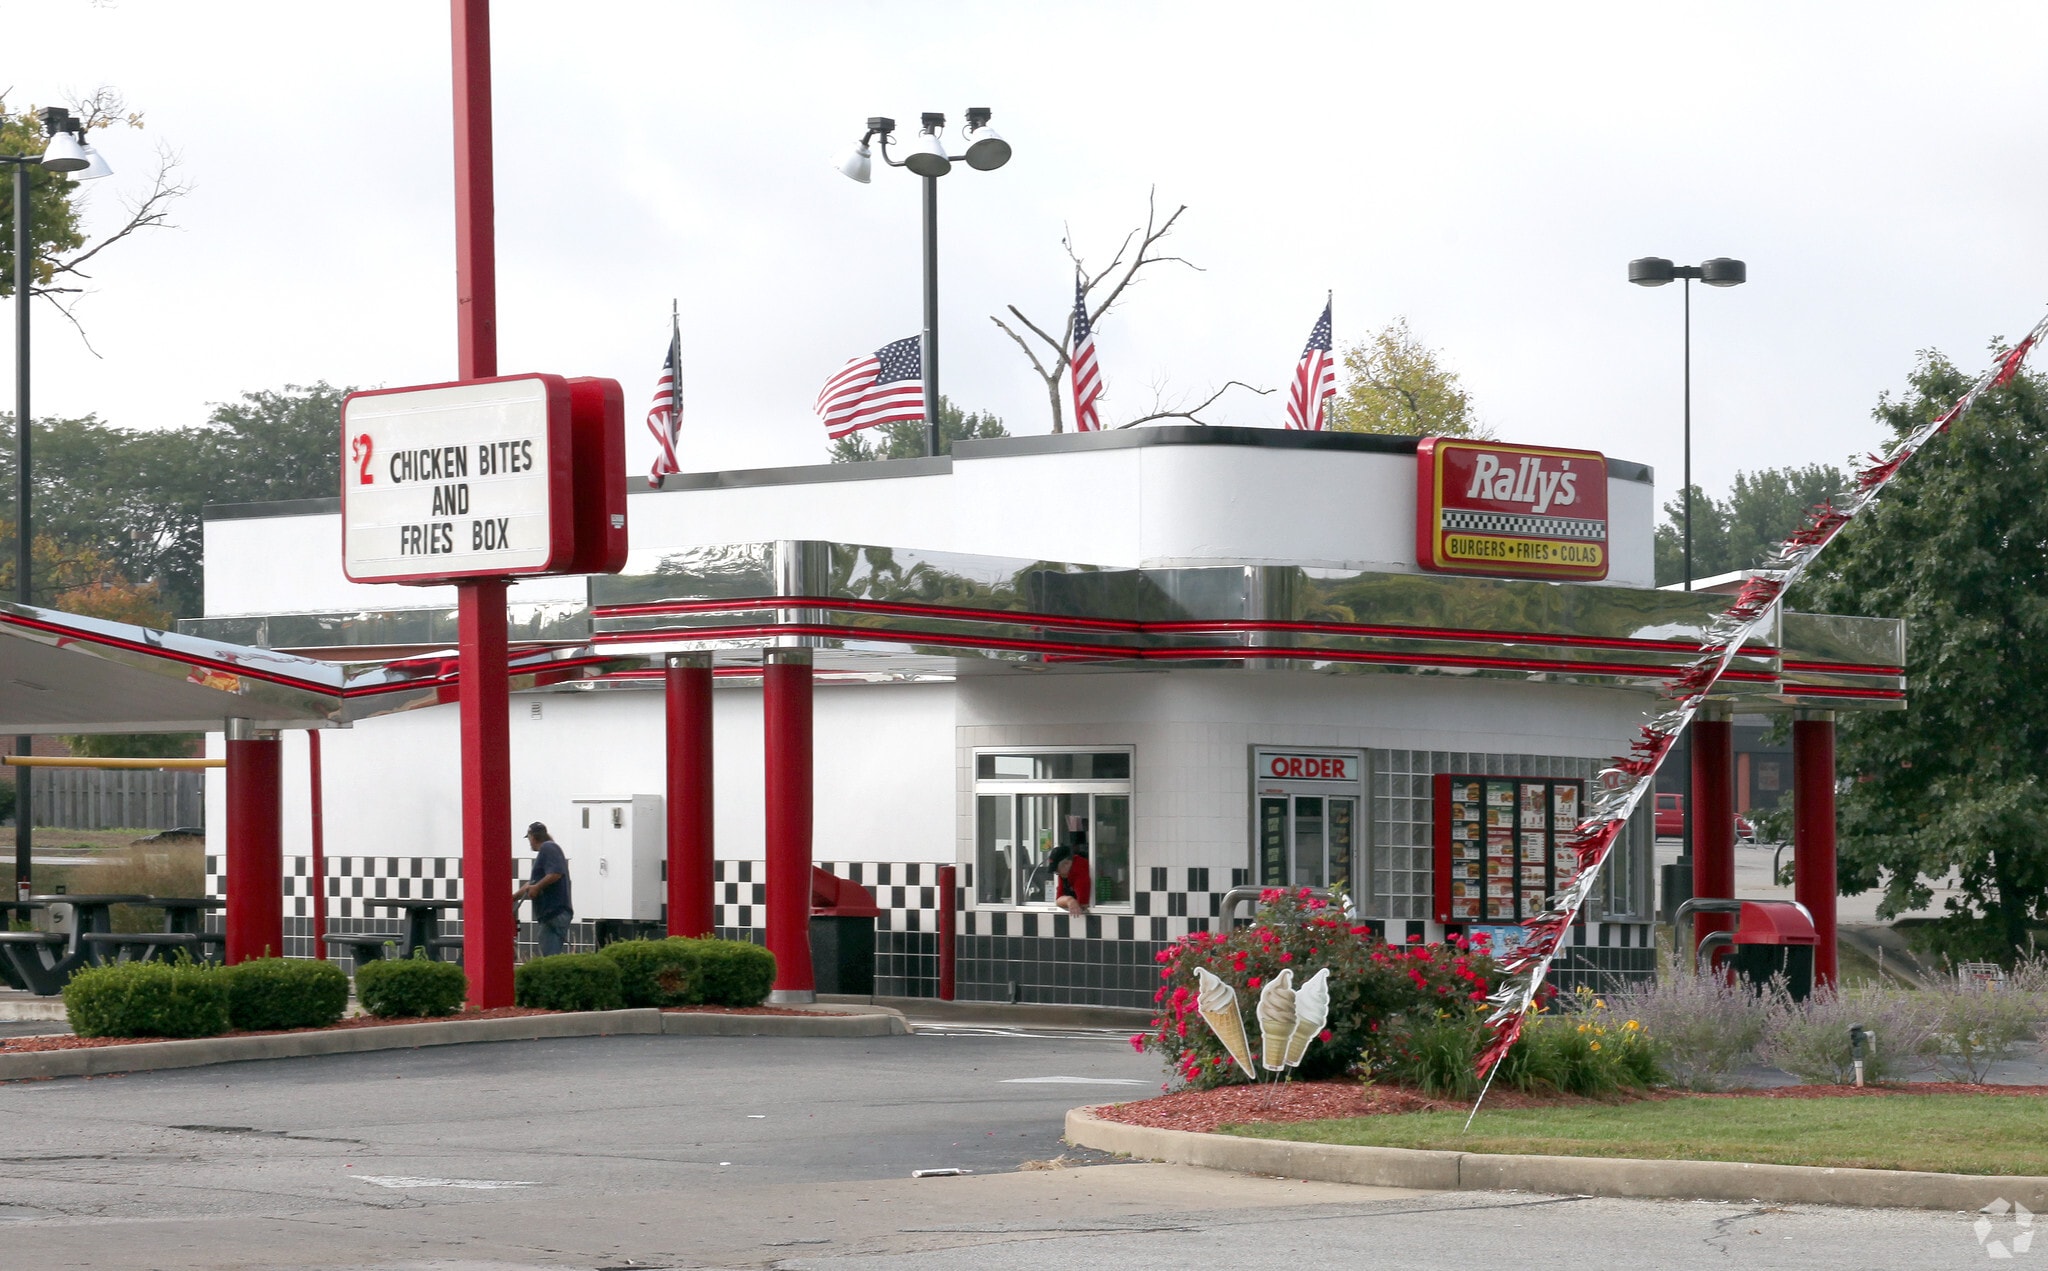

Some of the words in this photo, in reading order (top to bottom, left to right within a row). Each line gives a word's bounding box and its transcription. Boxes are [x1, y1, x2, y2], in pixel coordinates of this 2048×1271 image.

[352, 433, 374, 485] $2
[390, 446, 468, 484] CHICKEN
[479, 439, 532, 476] BITES
[431, 483, 470, 517] AND
[1466, 453, 1578, 514] Rally's
[400, 522, 453, 556] FRIES
[472, 518, 510, 551] BOX
[1451, 538, 1506, 557] BURGERS
[1516, 542, 1549, 560] FRIES
[1560, 545, 1597, 563] COLAS
[1271, 757, 1346, 778] ORDER
